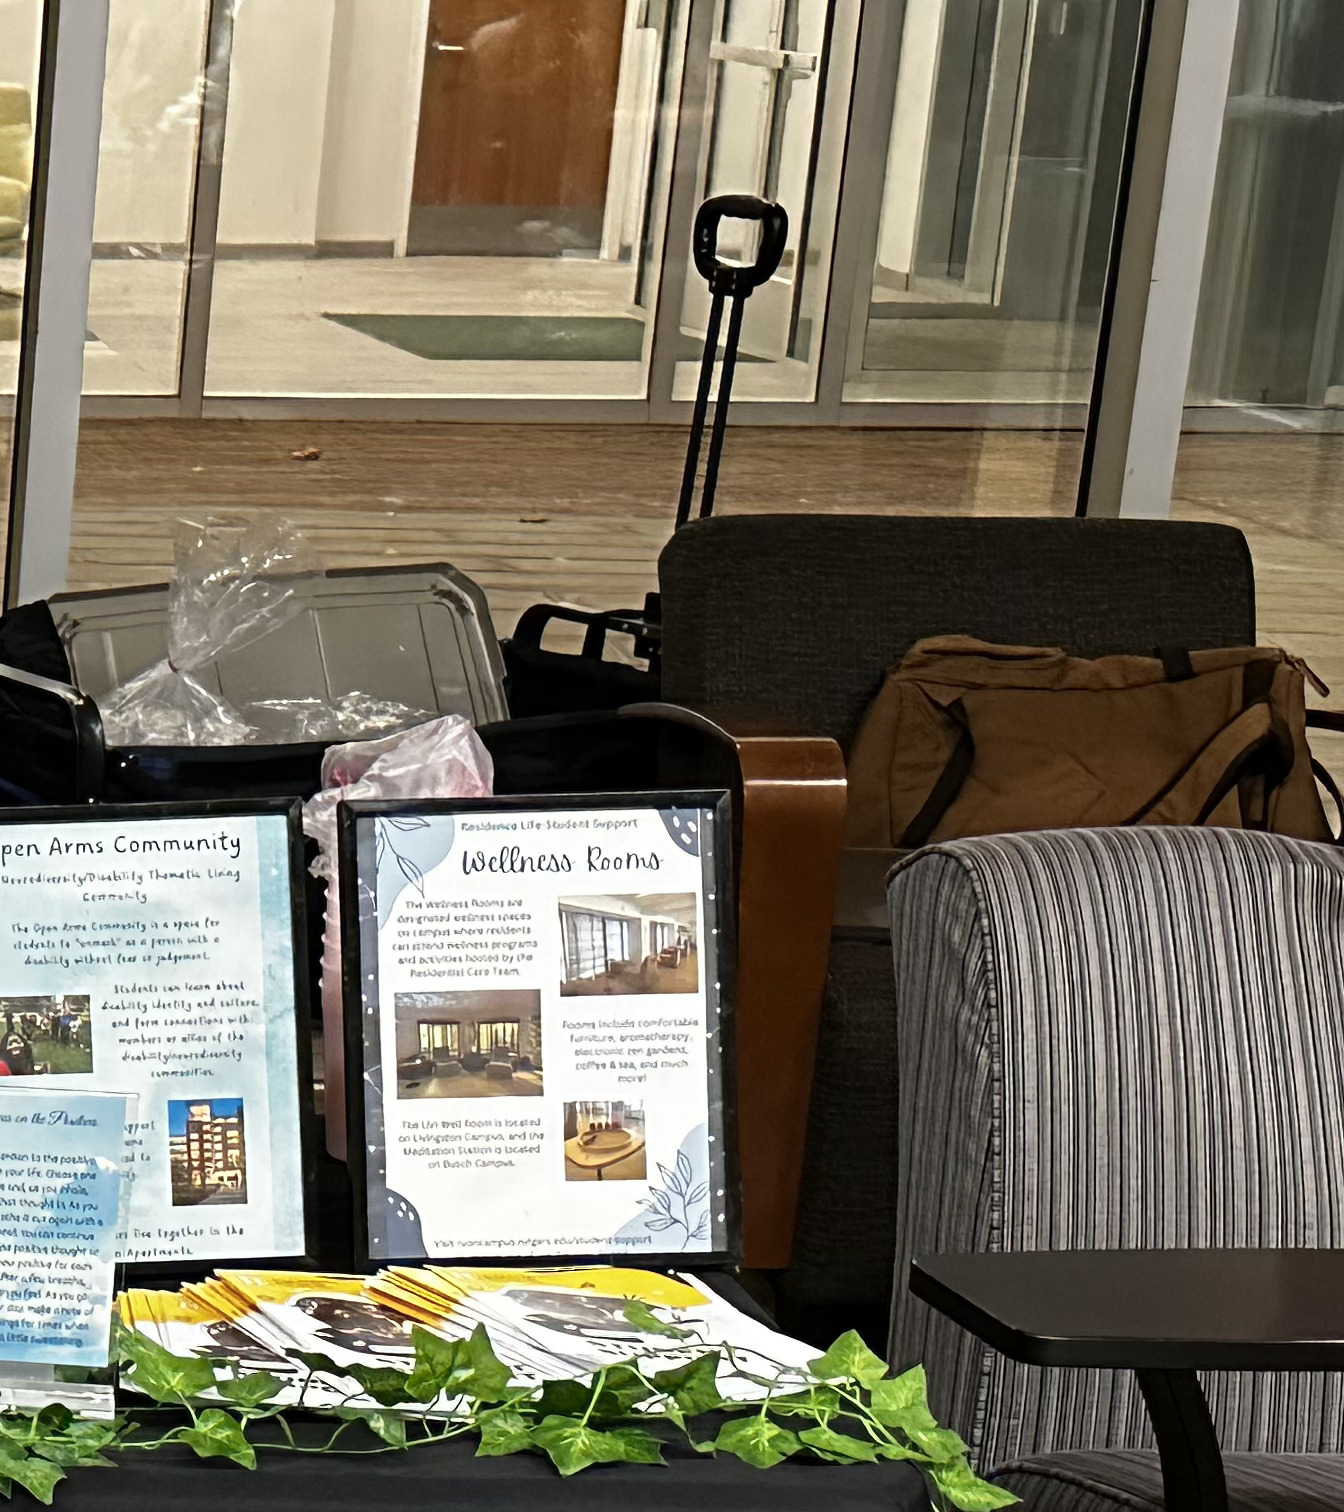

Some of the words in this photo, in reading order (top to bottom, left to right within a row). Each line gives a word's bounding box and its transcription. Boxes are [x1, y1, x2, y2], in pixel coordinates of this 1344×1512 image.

[461, 823, 516, 831] Residence
[547, 820, 589, 829] Student
[593, 819, 638, 830] Support
[49, 837, 103, 855] Arms
[114, 832, 240, 858] Community
[462, 846, 575, 875] Wellness
[587, 845, 663, 872] Rooms
[32, 1113, 45, 1124] the
